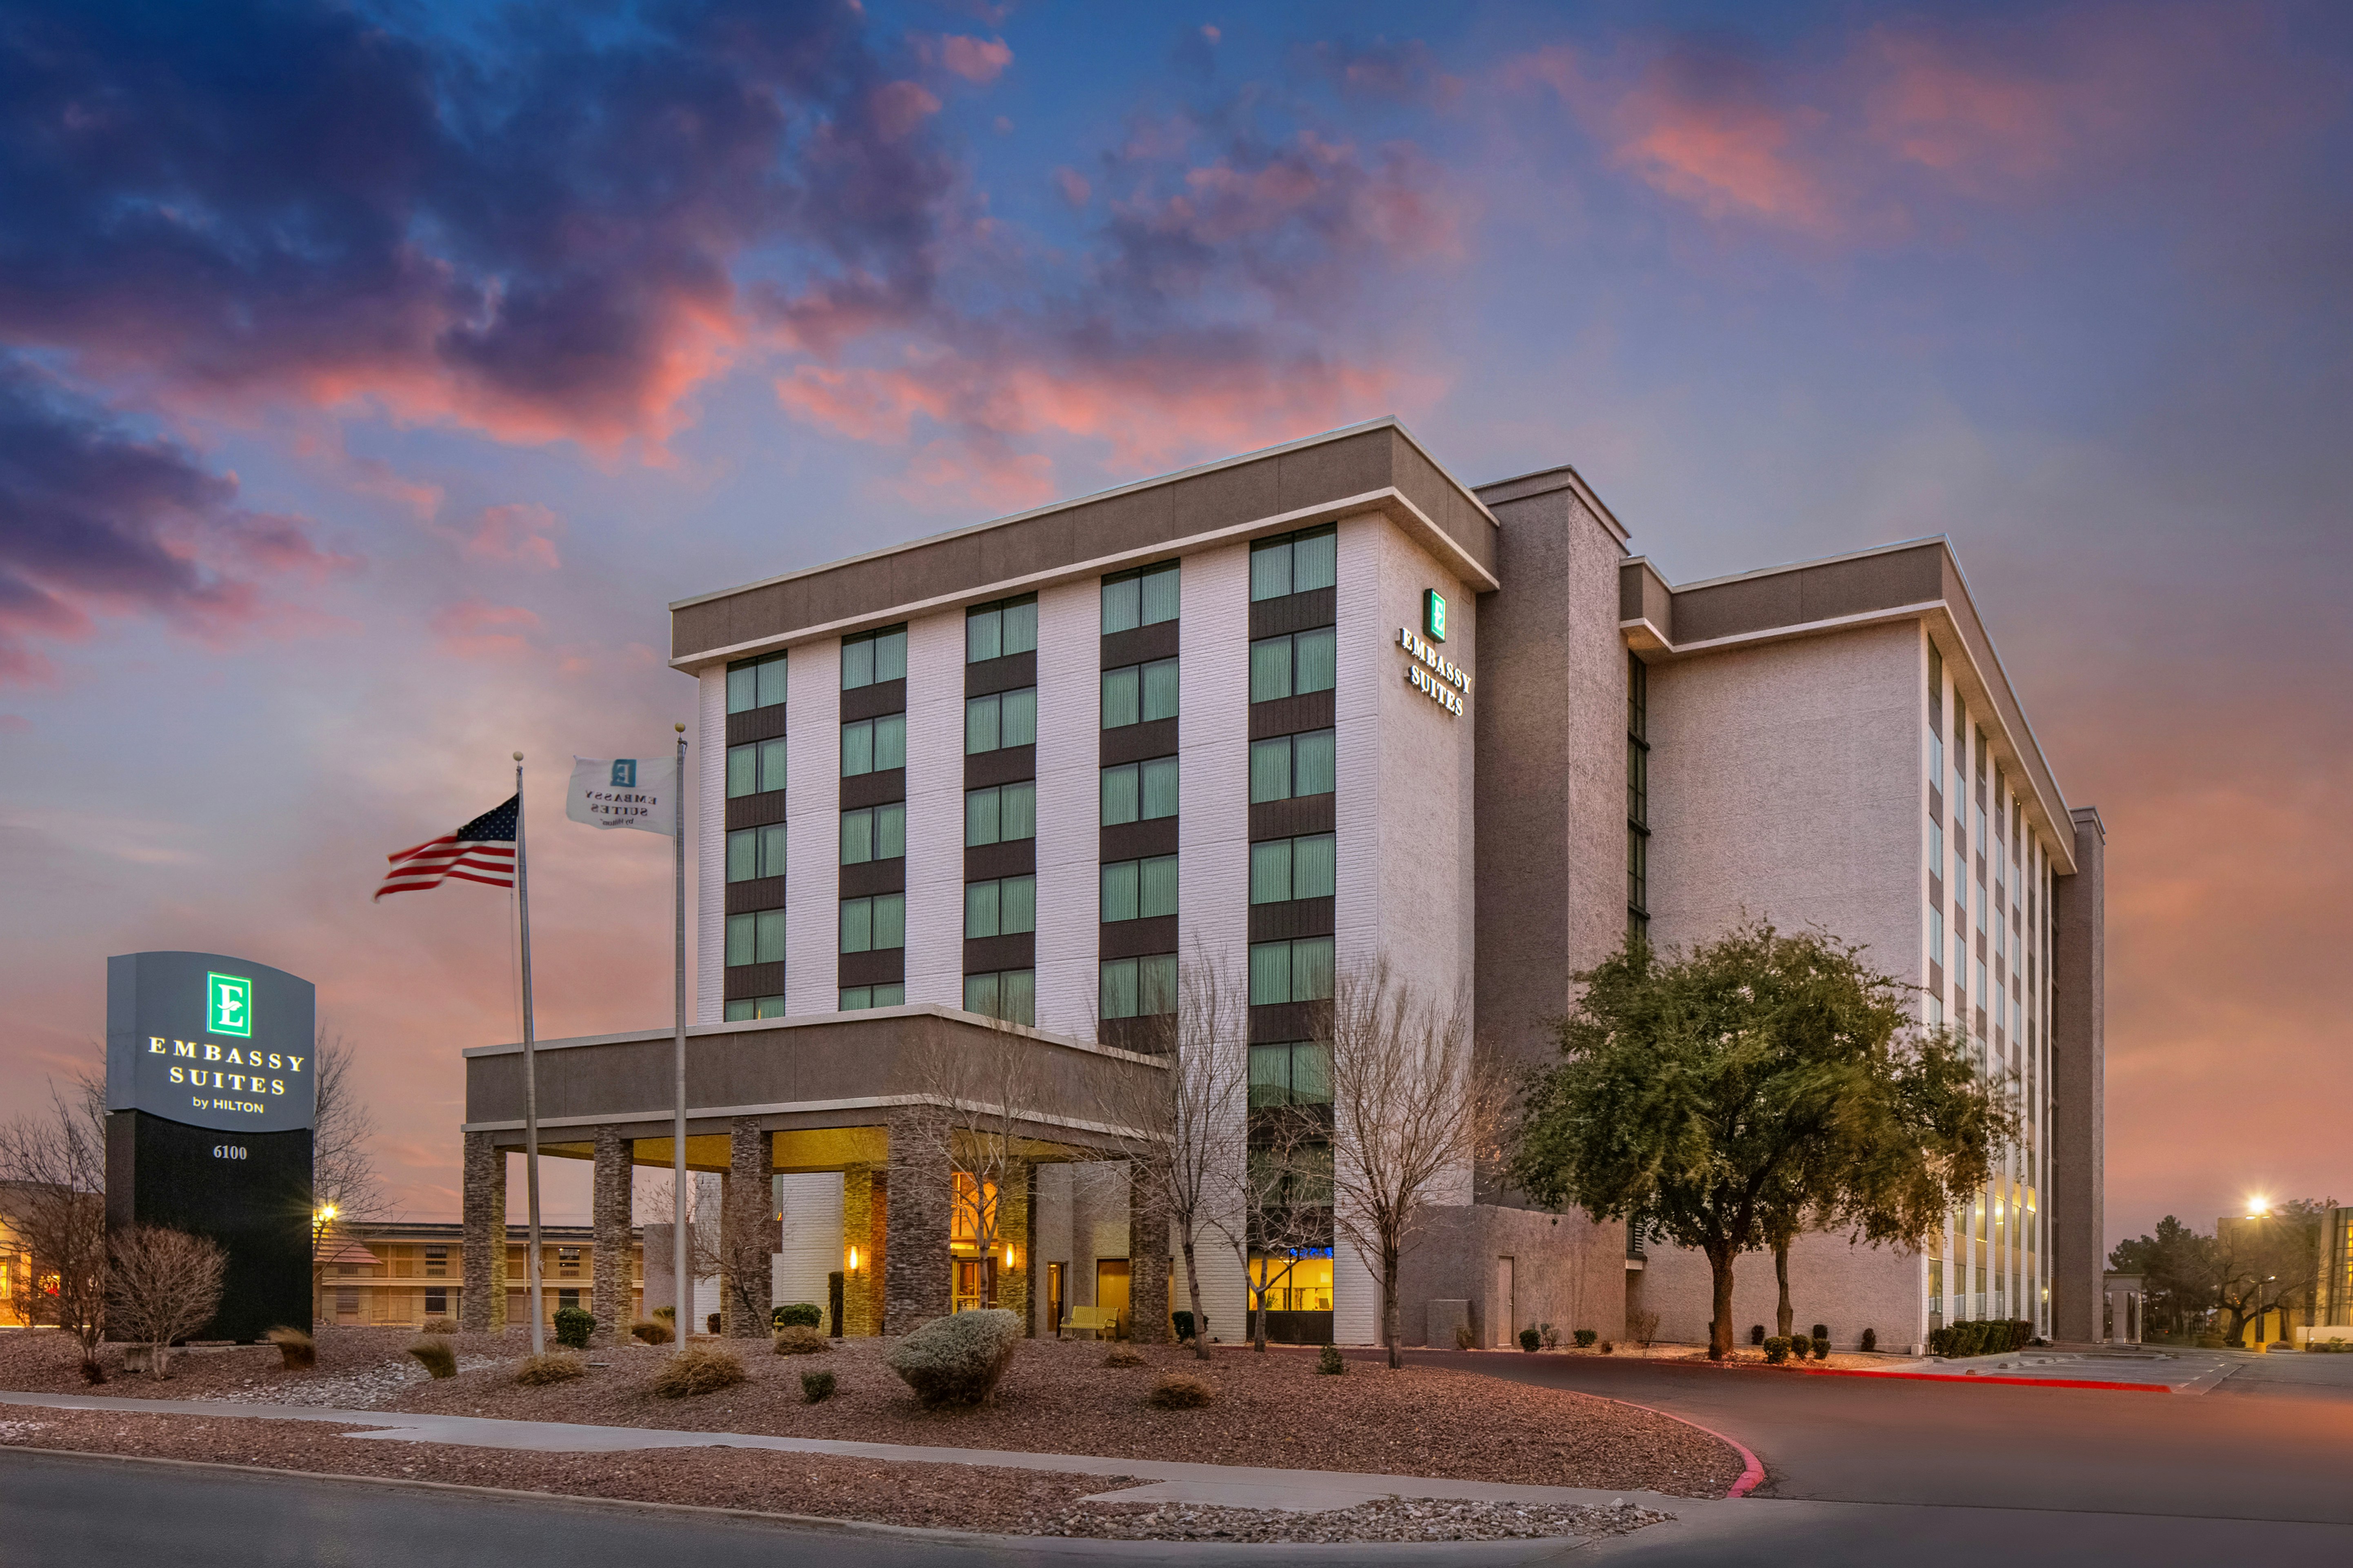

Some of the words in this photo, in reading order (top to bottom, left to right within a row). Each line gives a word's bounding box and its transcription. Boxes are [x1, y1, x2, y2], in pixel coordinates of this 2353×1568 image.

[1434, 599, 1443, 632] E
[1402, 627, 1472, 694] EMBASSY
[1411, 664, 1463, 717] SUITES
[217, 984, 243, 1028] E
[148, 1036, 305, 1072] EMBASSY
[170, 1066, 285, 1095] SUITES
[192, 1096, 209, 1110] by
[213, 1099, 264, 1114] HILTON
[213, 1145, 247, 1160] 6100
